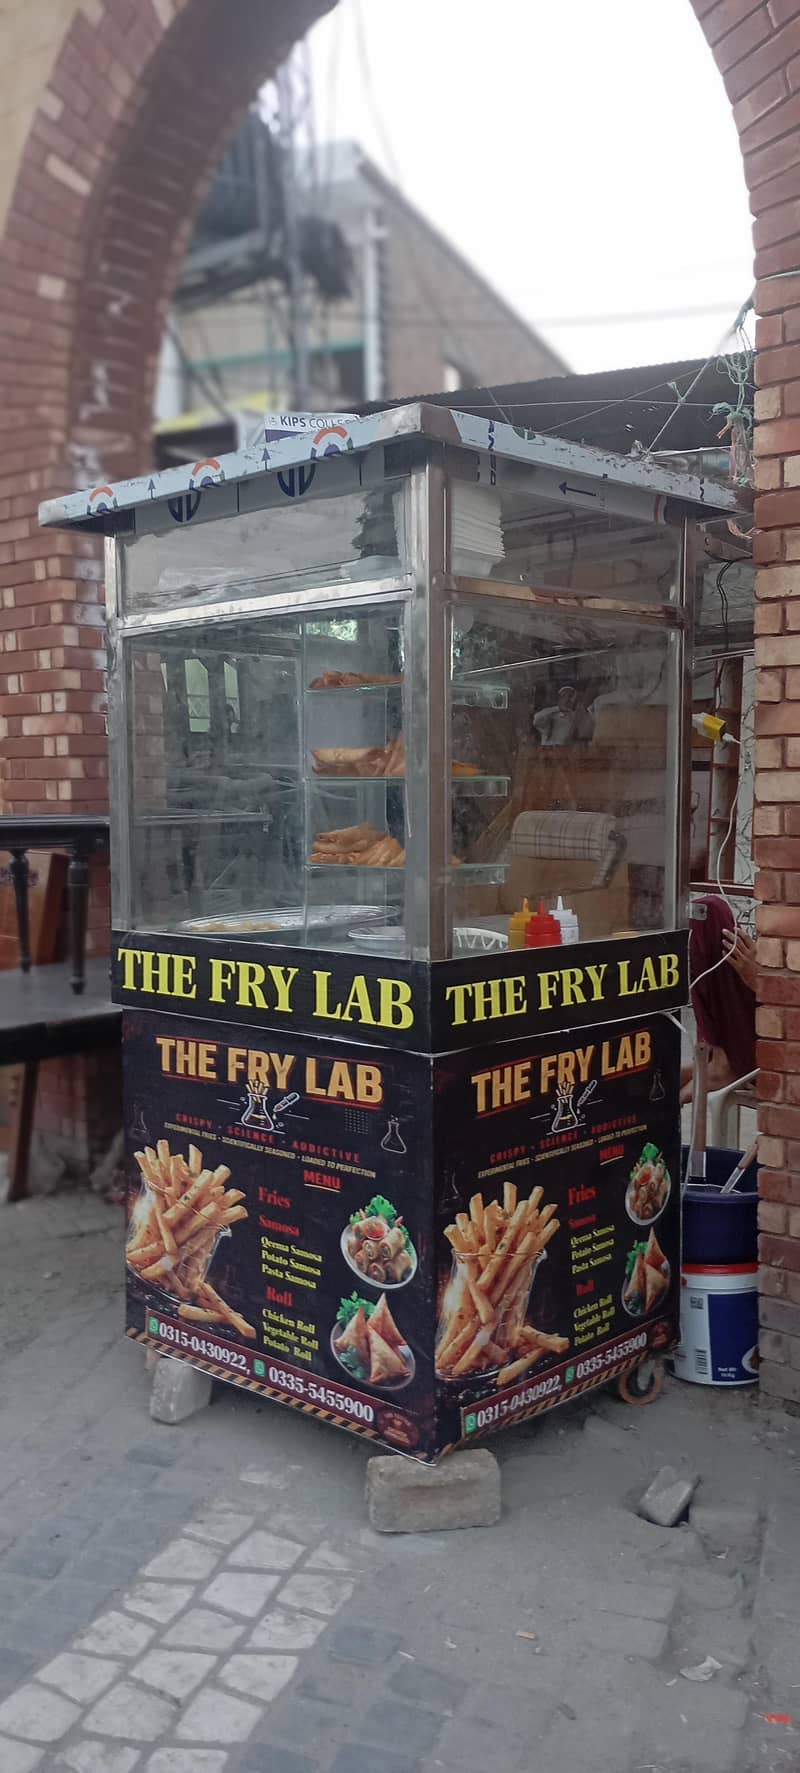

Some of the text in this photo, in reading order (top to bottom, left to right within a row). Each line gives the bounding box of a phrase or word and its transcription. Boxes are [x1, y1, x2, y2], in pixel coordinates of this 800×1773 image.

[280, 416, 306, 428] KIPS
[118, 948, 415, 1030] THE FRY LAB
[446, 953, 680, 1026] THE FRY LAB
[156, 1037, 383, 1105] THE FRY LAB
[471, 1031, 651, 1113] THE FRY LAB
[175, 1113, 361, 1164] CRISPY SCIENCE ADDICTIVE
[264, 1147, 296, 1160] SEASONED
[301, 1155, 326, 1167] LOADED
[327, 1161, 335, 1169] TO
[335, 1162, 376, 1179] PERFECTION
[600, 1144, 625, 1160] MENU
[304, 1170, 341, 1190] MENU
[258, 1186, 291, 1208] Fries
[259, 1215, 300, 1236] Samosa
[262, 1250, 322, 1276] Potato Samosa
[290, 1245, 323, 1262] Samosa
[262, 1263, 317, 1289] Pasta Samosa
[266, 1285, 293, 1308] Roll
[262, 1308, 316, 1335] Chicken Roll
[262, 1321, 319, 1350] Vegetable Roll
[263, 1335, 312, 1361] Potato Roll
[159, 1321, 374, 1423] 0315-0430922, 0335-5455900
[477, 1332, 648, 1428] 0315-0430922, 0335-5455900
